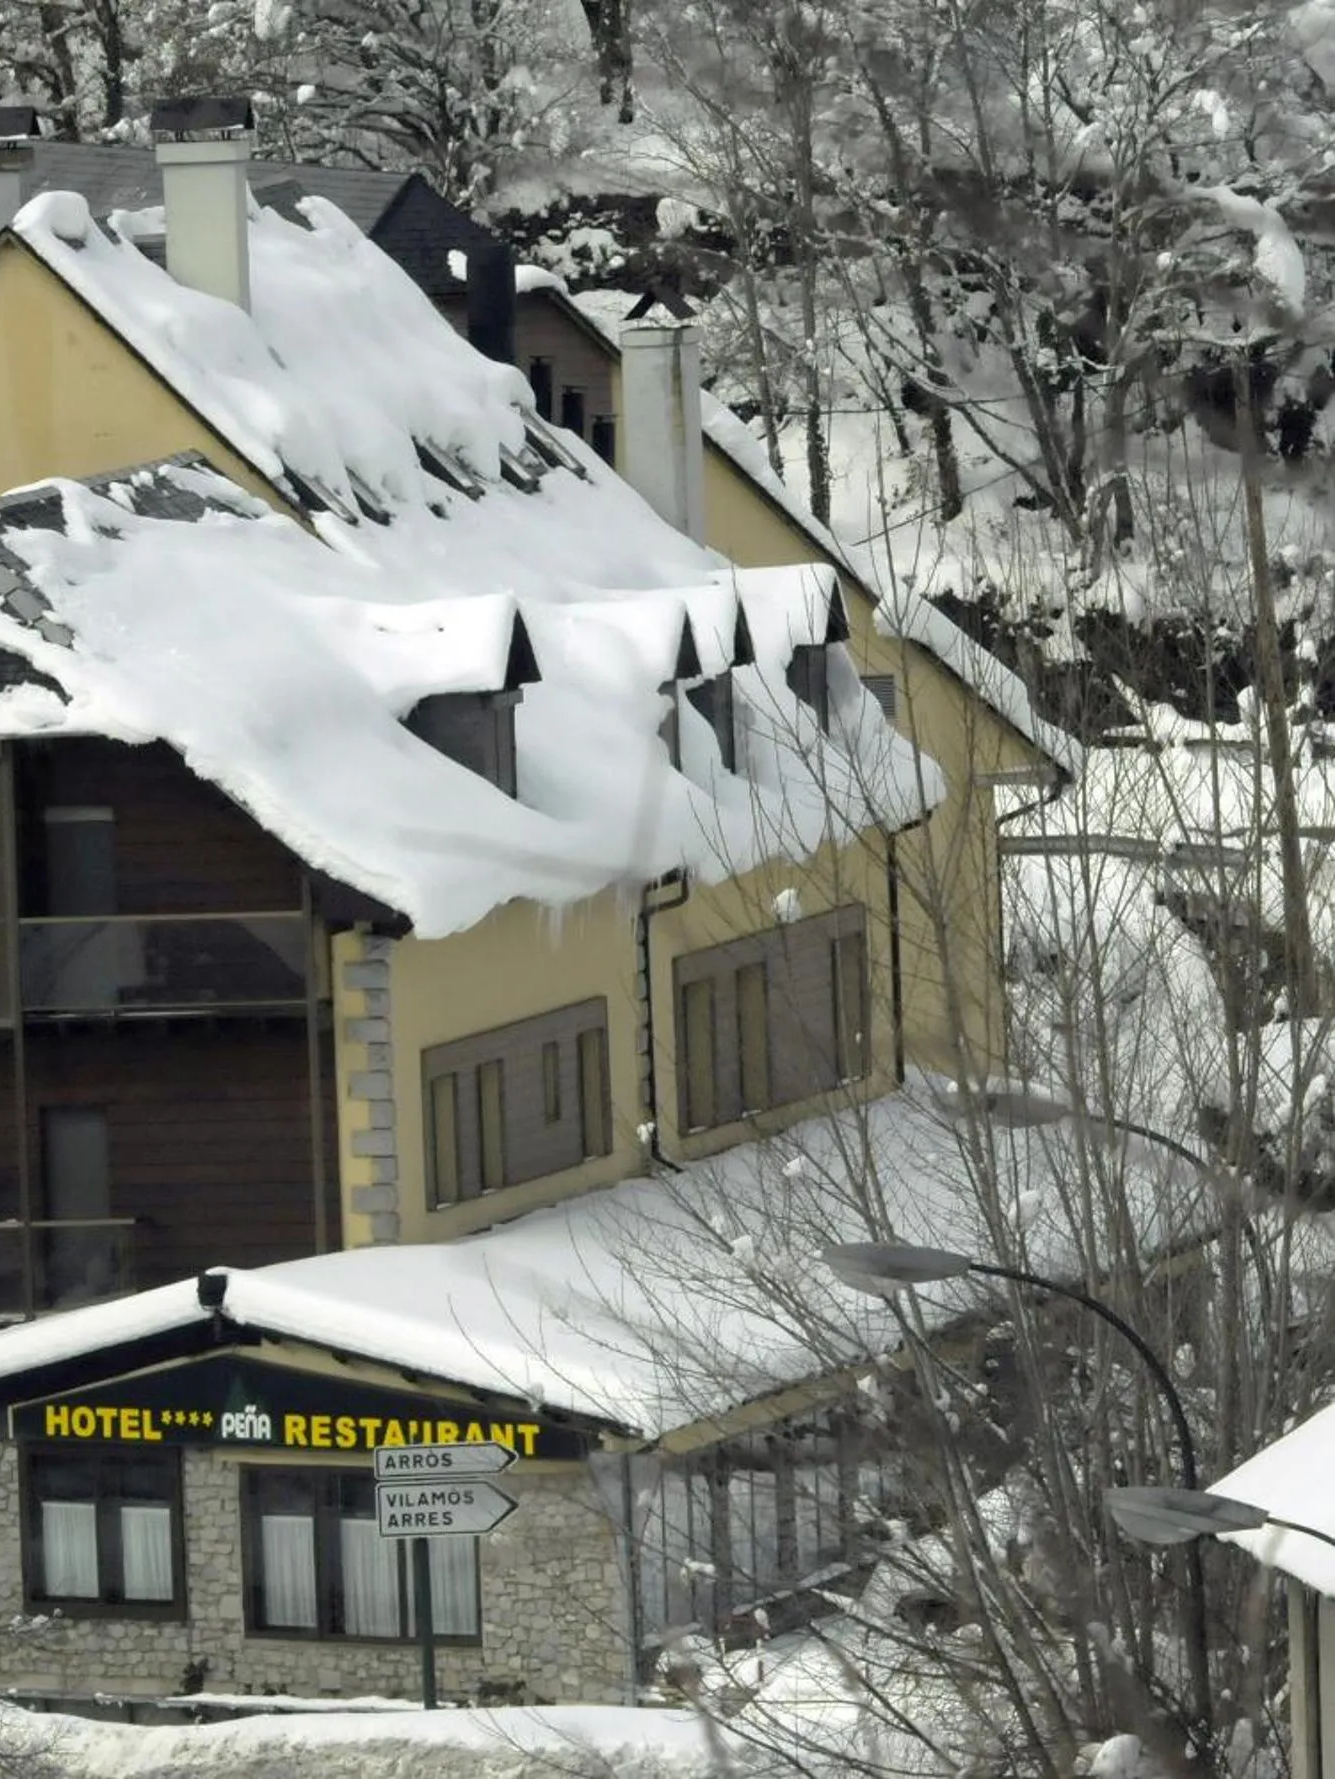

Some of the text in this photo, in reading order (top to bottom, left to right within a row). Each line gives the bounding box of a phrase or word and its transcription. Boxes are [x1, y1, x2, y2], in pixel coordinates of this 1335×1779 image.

[45, 1404, 162, 1441] HOTEL
[220, 1404, 272, 1440] PEÑA
[385, 1449, 453, 1469] ARRÒS
[387, 1511, 453, 1528] ARRES
